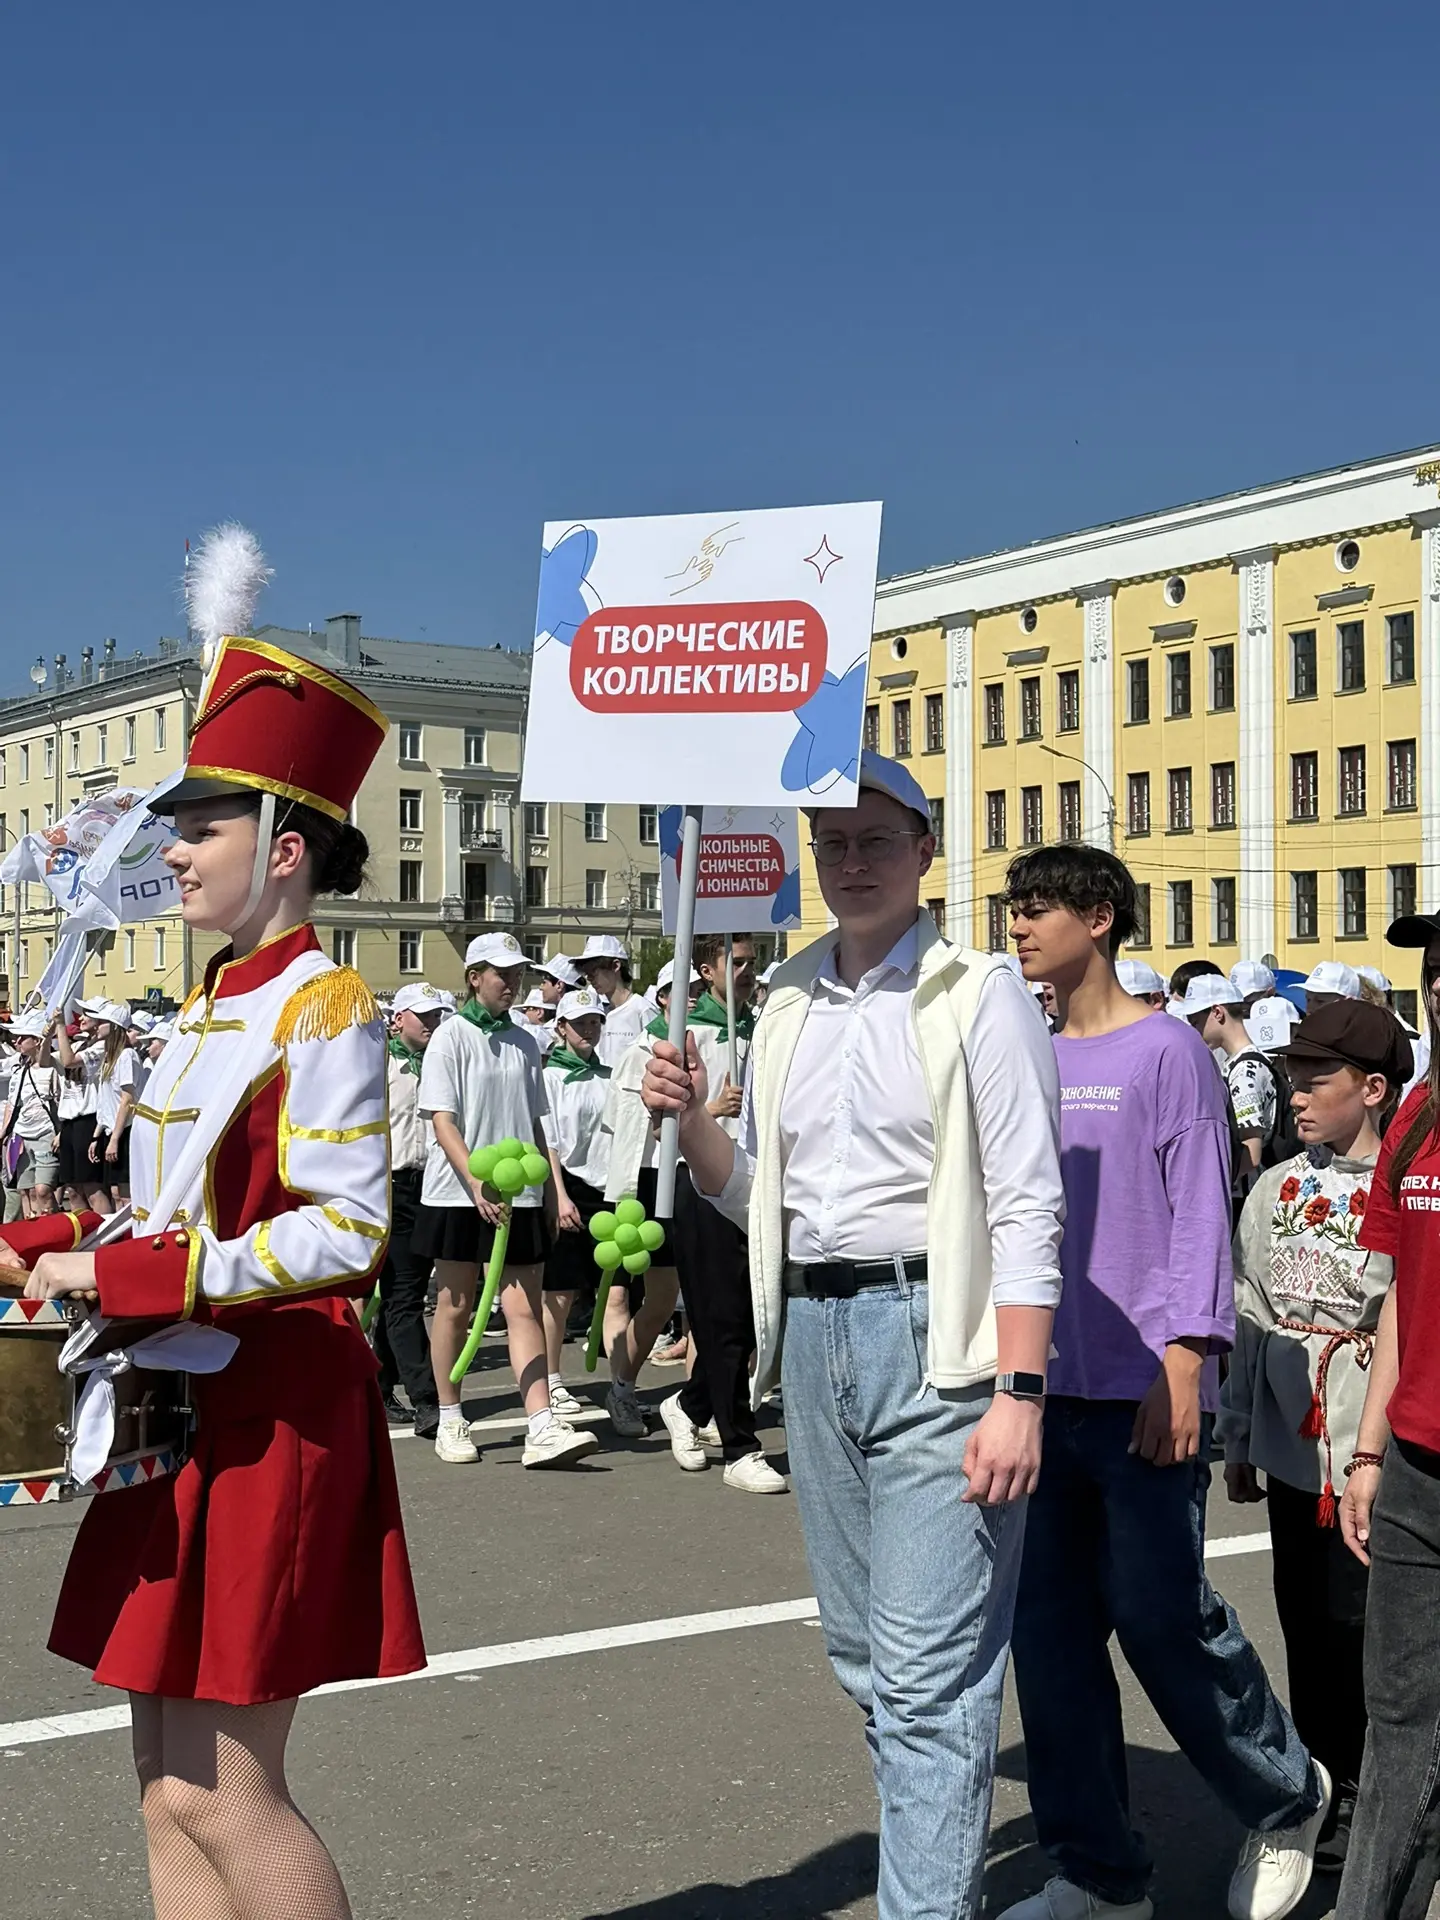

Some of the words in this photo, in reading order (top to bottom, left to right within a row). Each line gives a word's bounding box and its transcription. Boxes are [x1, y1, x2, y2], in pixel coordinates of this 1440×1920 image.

[593, 619, 806, 655] ТВОРЧЕСКИЕ
[582, 662, 811, 696] КОЛЛЕКТИВЫ
[699, 839, 771, 854] КОЛЬНЫЕ
[698, 858, 780, 874] СНИЧЕСТВА
[707, 877, 769, 893] ЮННАТЫ
